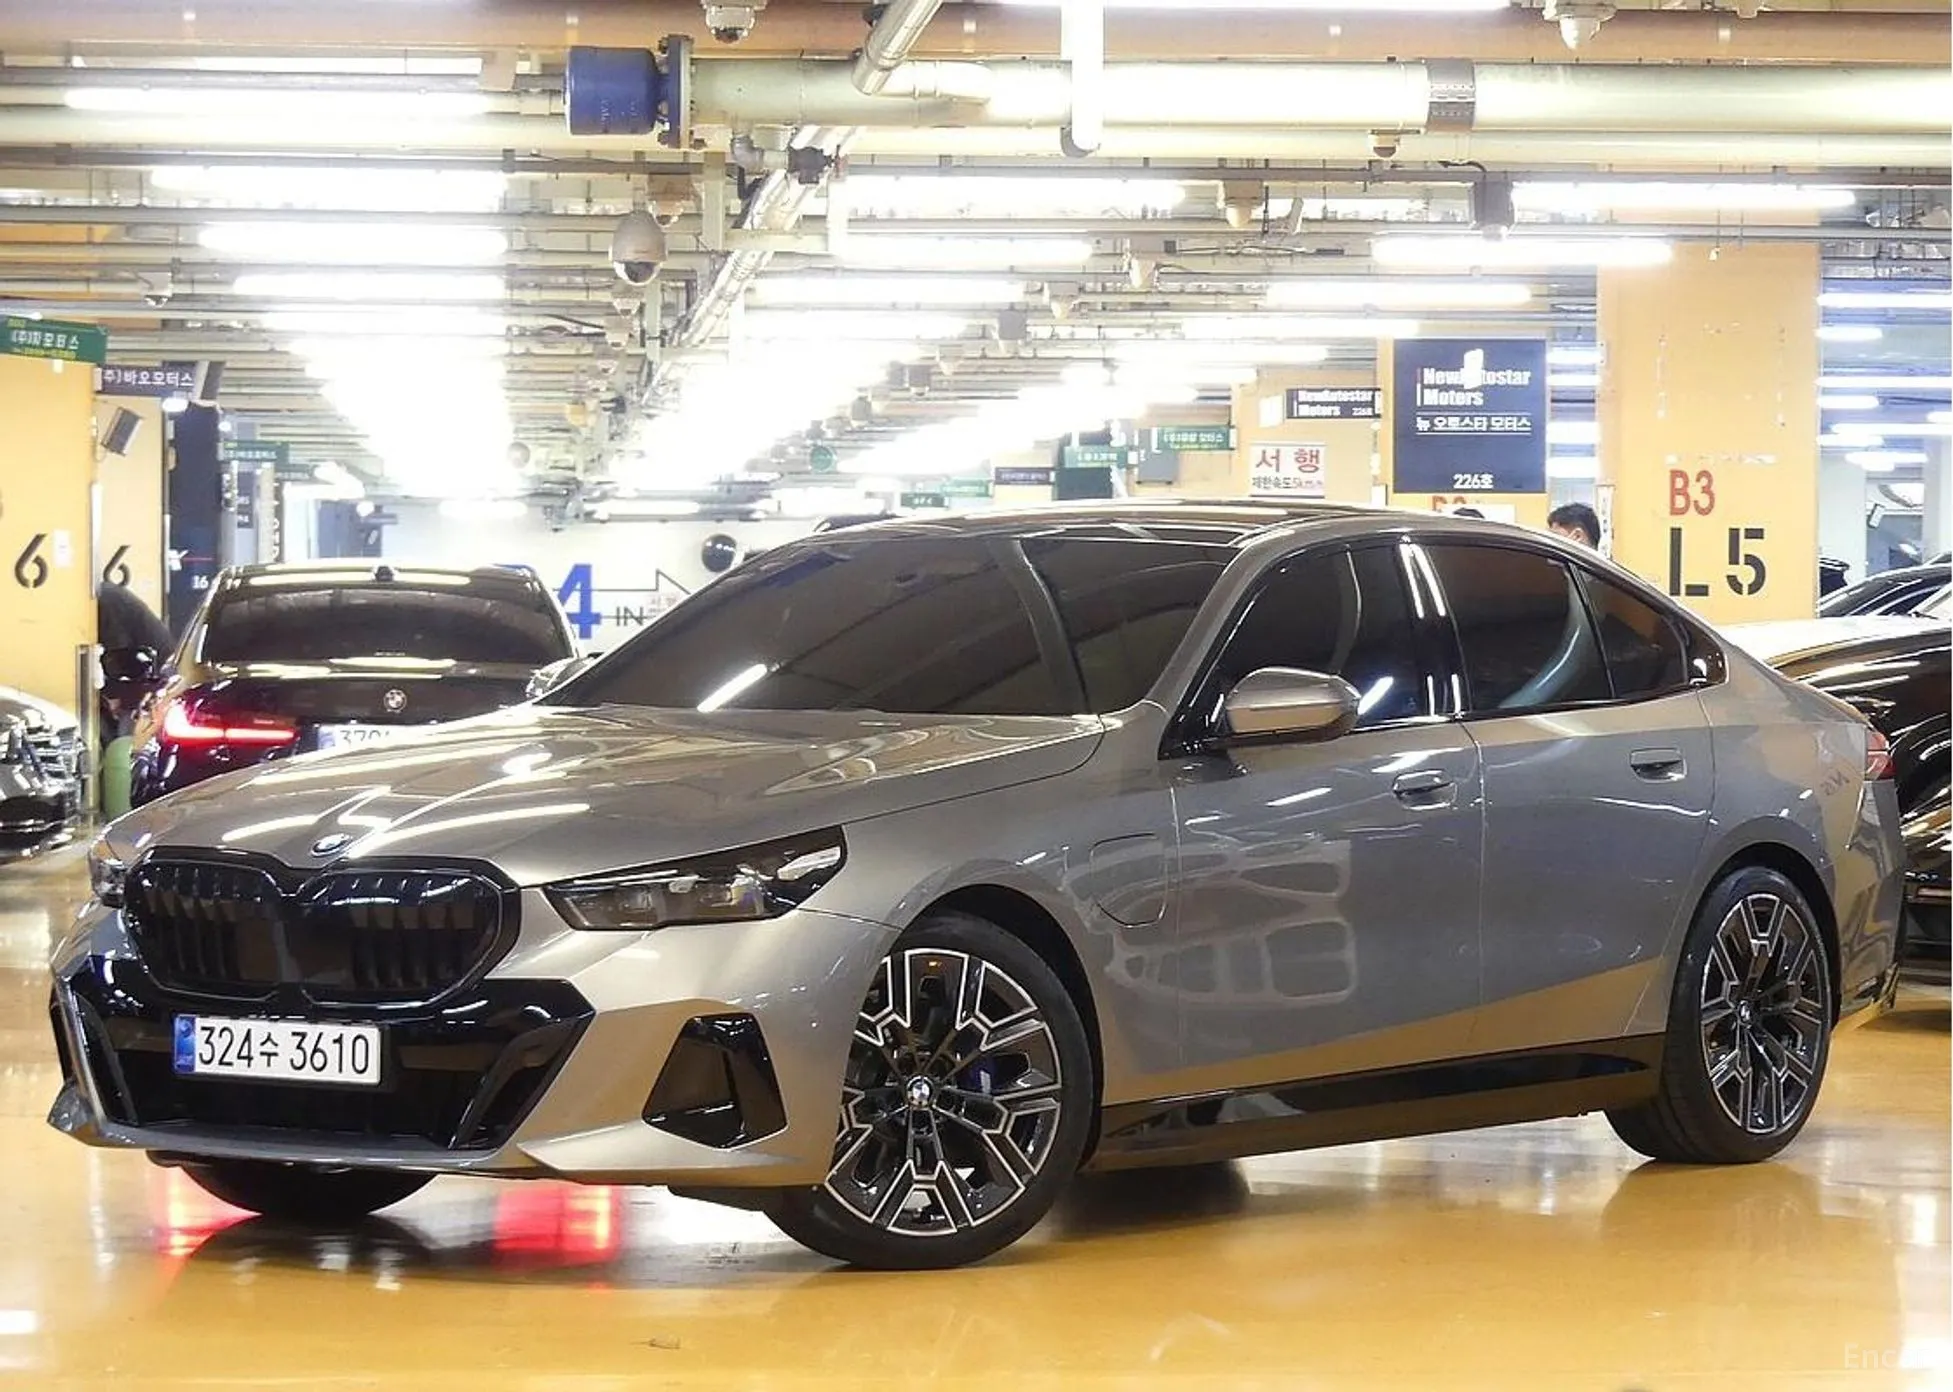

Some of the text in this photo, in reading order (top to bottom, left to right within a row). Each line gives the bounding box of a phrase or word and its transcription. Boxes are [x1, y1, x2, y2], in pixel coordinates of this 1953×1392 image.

[1423, 367, 1532, 386] Newtostar
[1489, 416, 1532, 431] 모터스
[1452, 473, 1494, 489] 226호
[1669, 469, 1716, 517] B3
[14, 533, 48, 589] 6
[103, 545, 131, 586] 6
[1726, 528, 1767, 596] 5
[616, 606, 645, 627] IN
[198, 1026, 370, 1075] 324수 3610
